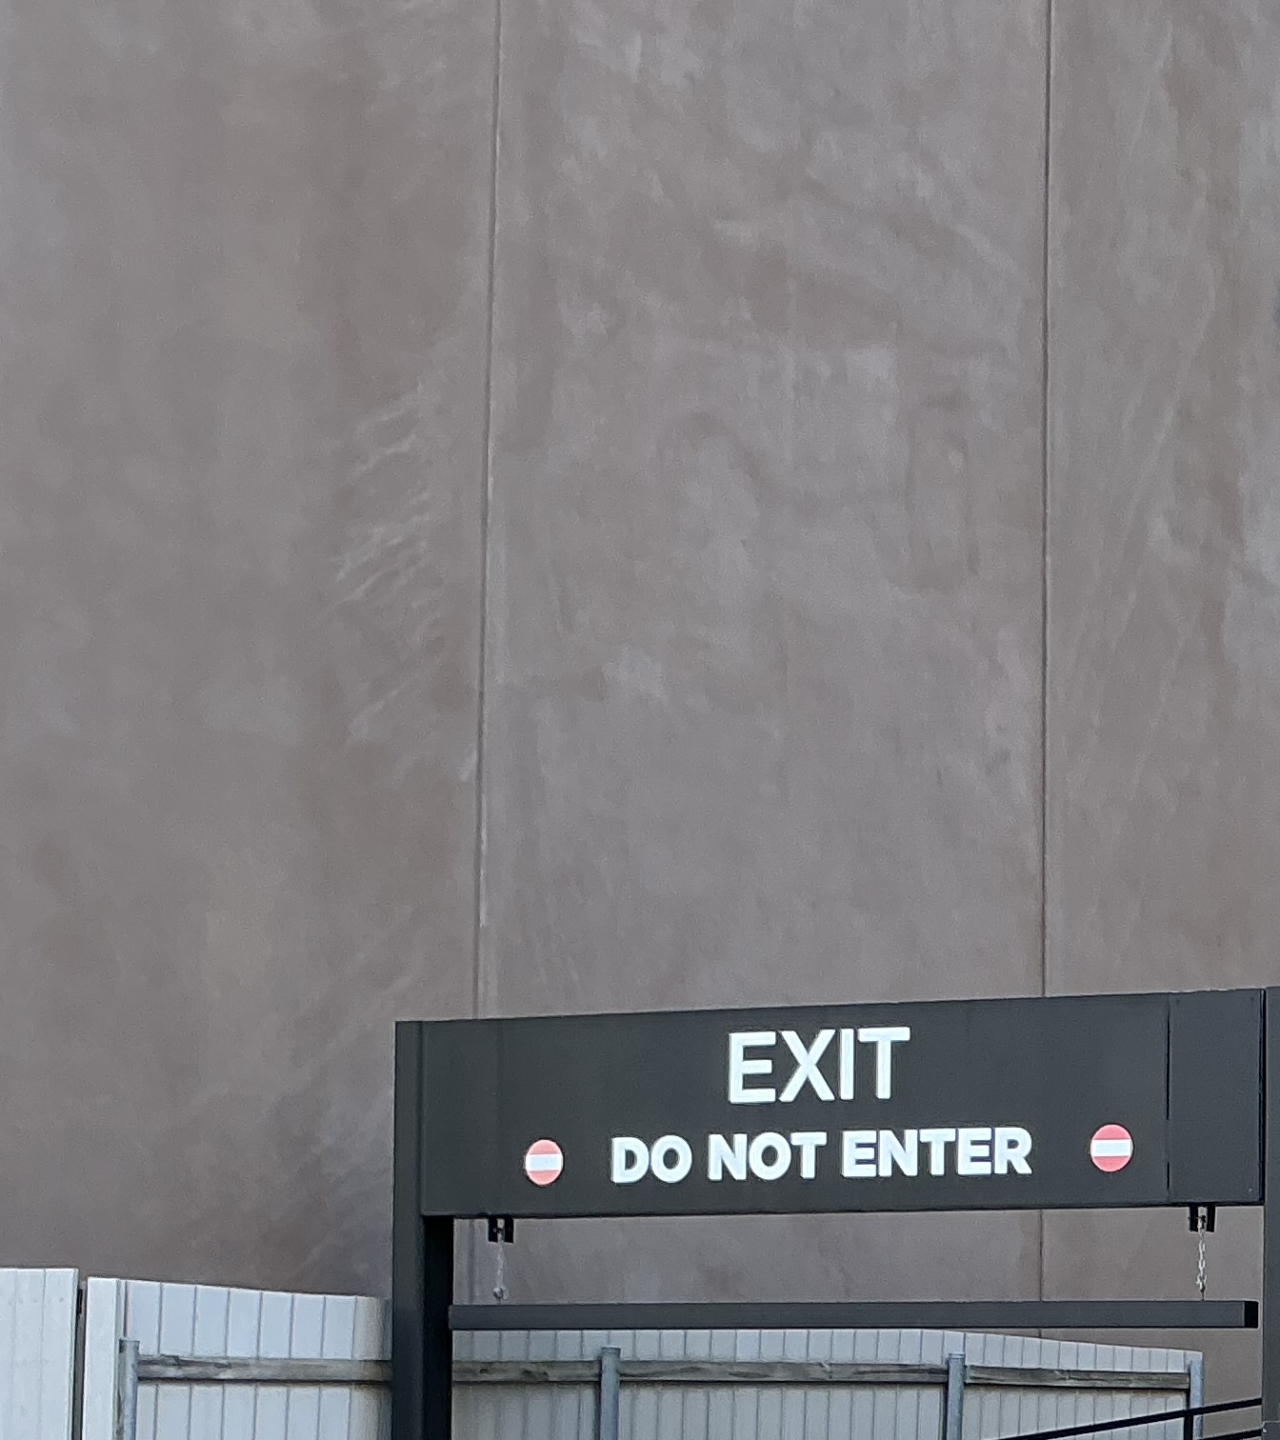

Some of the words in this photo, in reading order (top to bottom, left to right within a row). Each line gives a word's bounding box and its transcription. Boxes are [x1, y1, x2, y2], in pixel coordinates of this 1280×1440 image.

[729, 1027, 911, 1103] EXIT
[612, 1134, 693, 1183] DO
[708, 1131, 828, 1180] NOT
[842, 1127, 1033, 1177] ENTER
